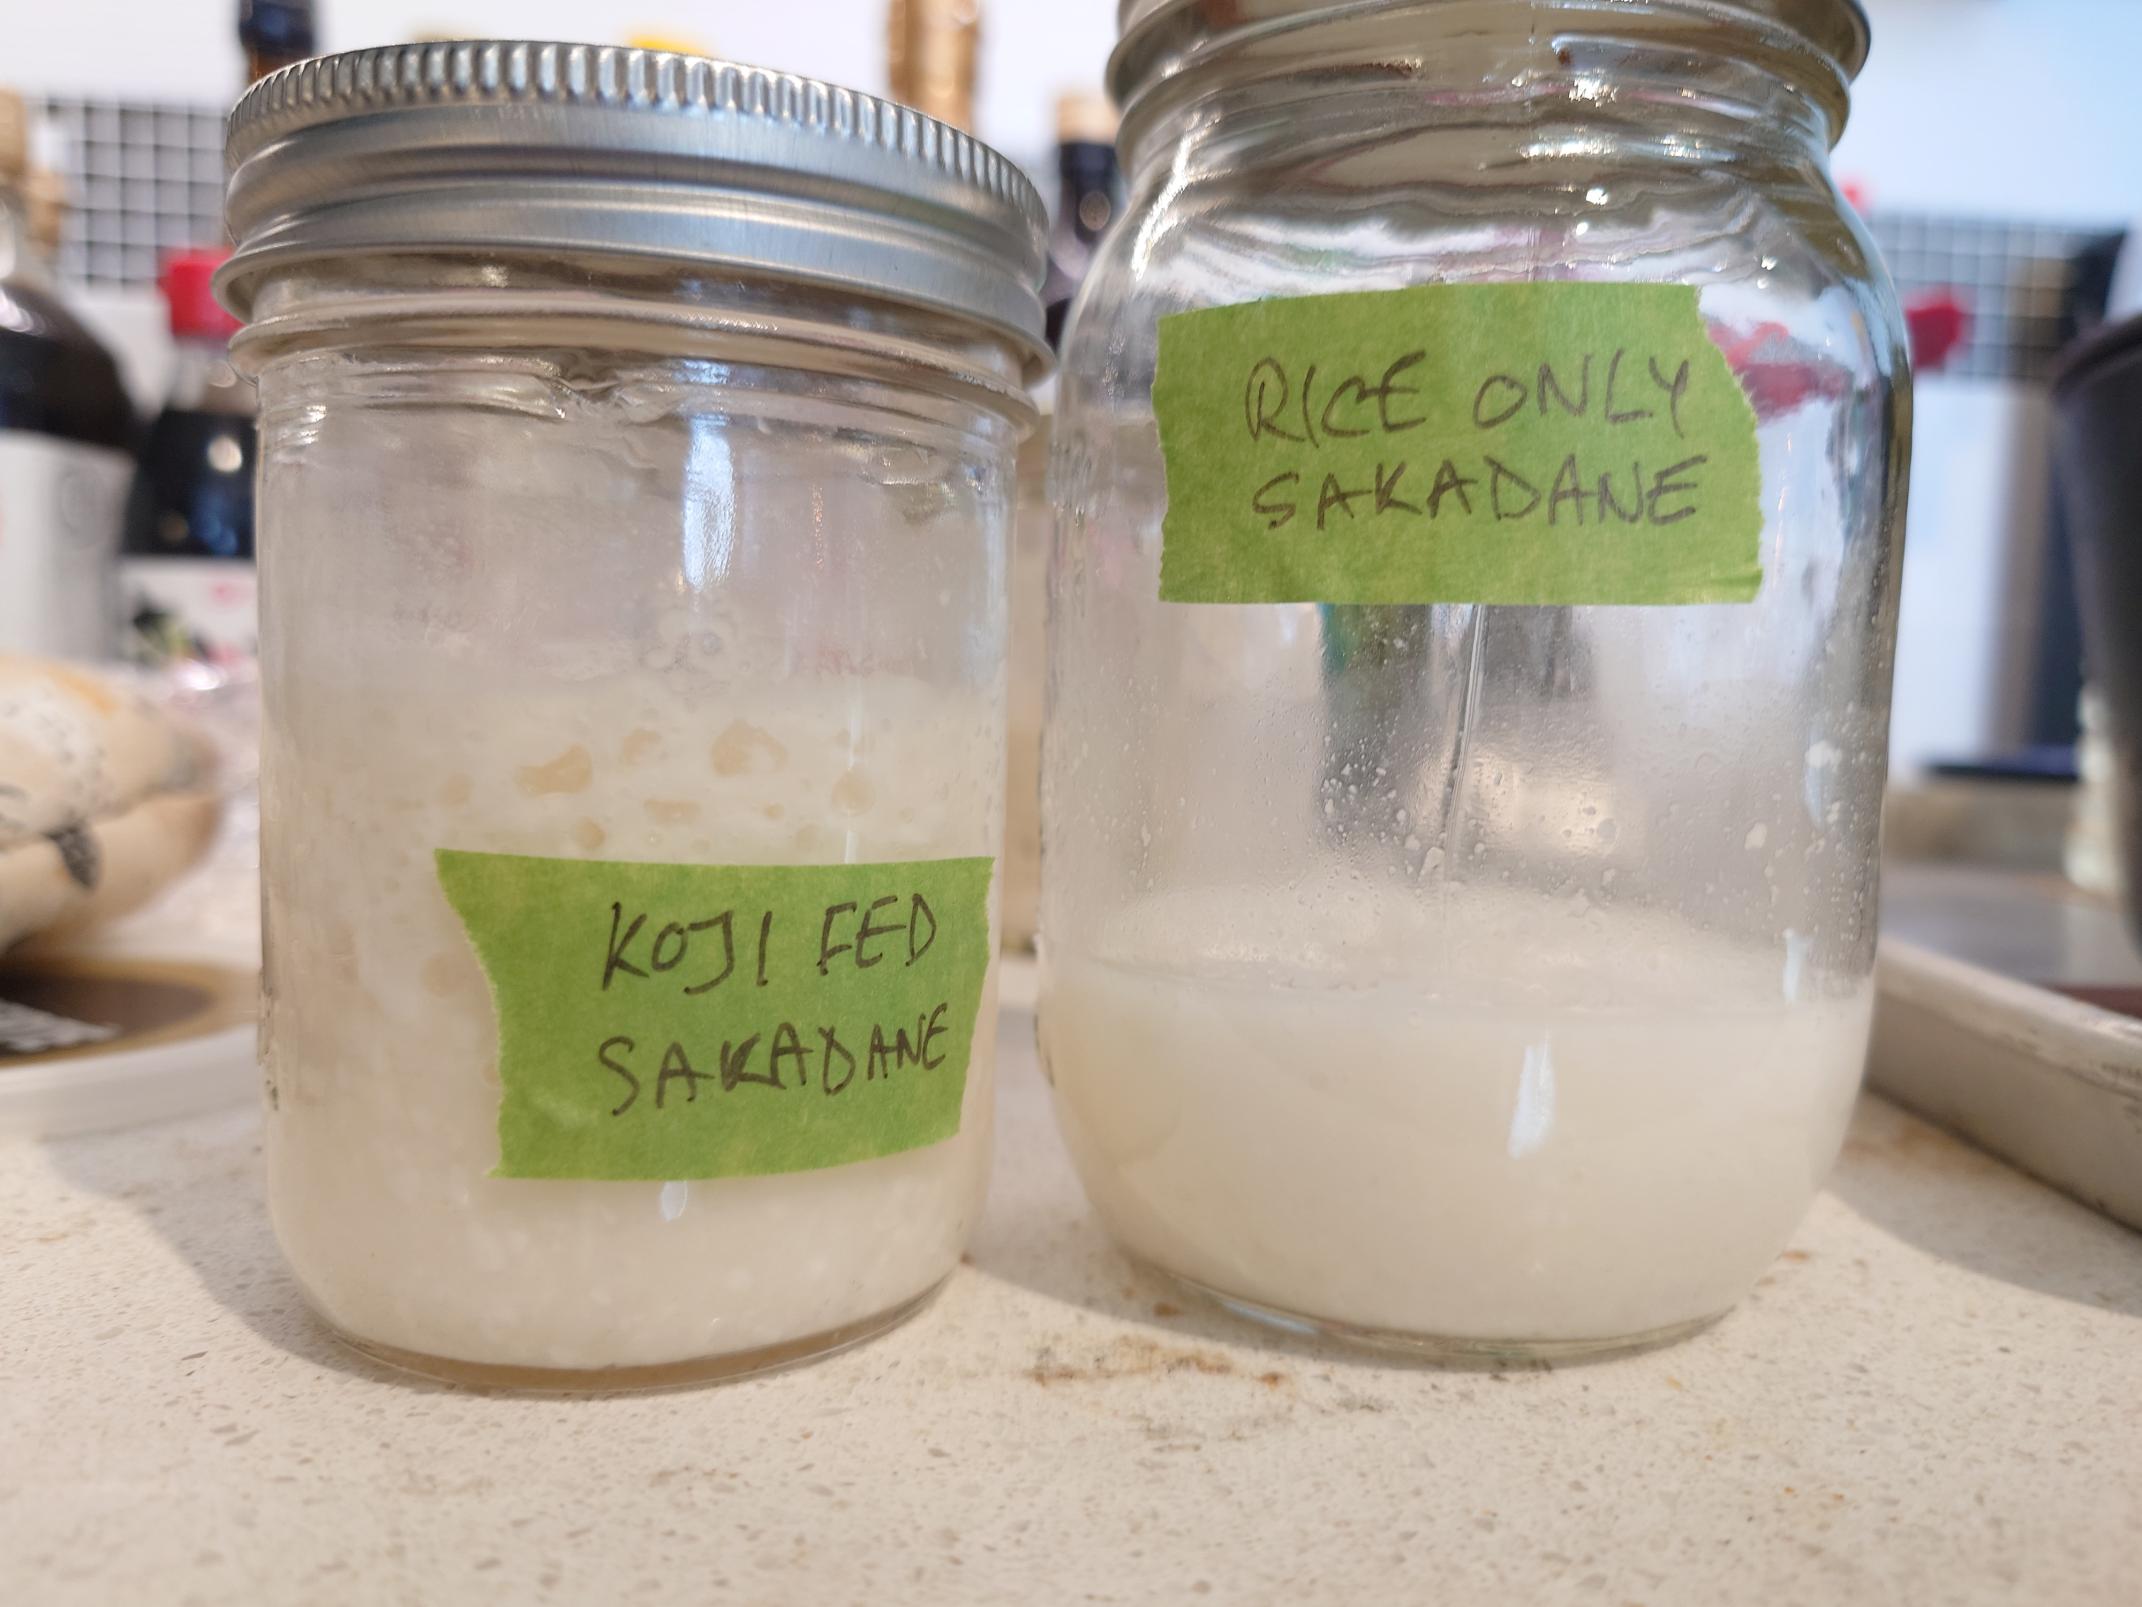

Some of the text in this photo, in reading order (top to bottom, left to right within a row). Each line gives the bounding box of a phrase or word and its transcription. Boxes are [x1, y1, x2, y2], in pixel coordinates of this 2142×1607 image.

[1245, 347, 1690, 448] RICE ONLY
[1250, 453, 1708, 531] SAKADANE
[601, 892, 938, 995] KOJI FED
[599, 1001, 949, 1117] SAKADANE
